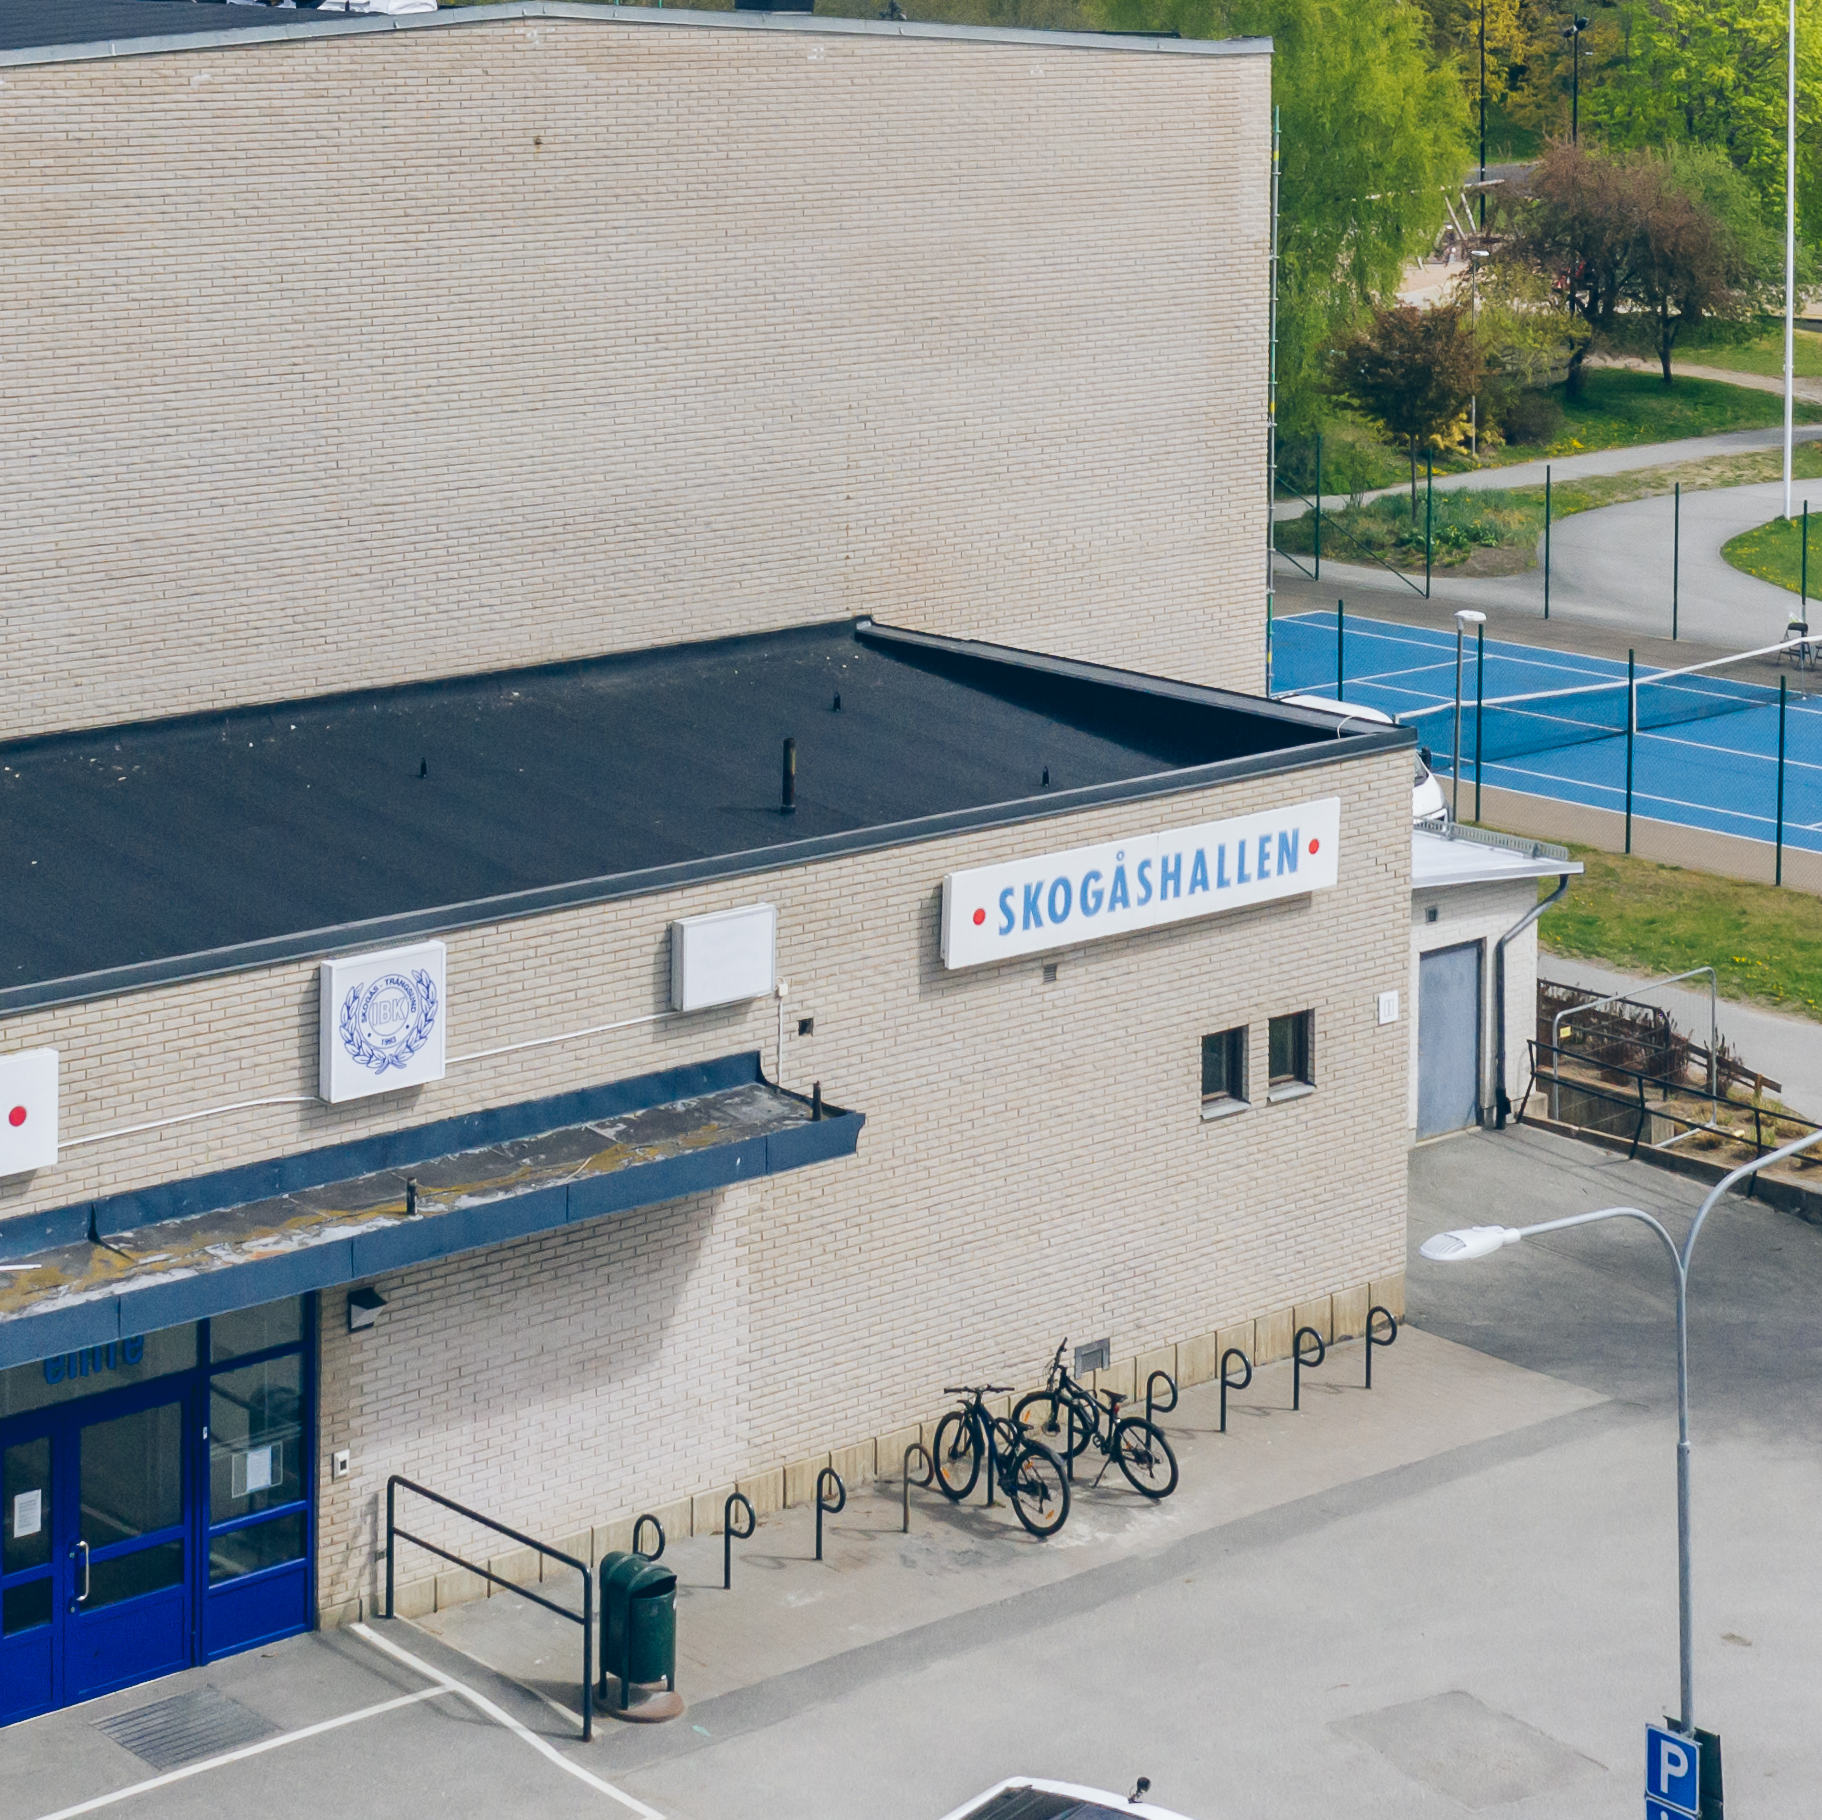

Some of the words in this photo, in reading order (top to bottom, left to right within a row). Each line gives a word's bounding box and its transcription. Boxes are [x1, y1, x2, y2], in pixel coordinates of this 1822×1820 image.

[998, 827, 1300, 936] SKOGÅSHALLEN
[371, 996, 406, 1027] IBK
[1660, 1738, 1689, 1794] P
